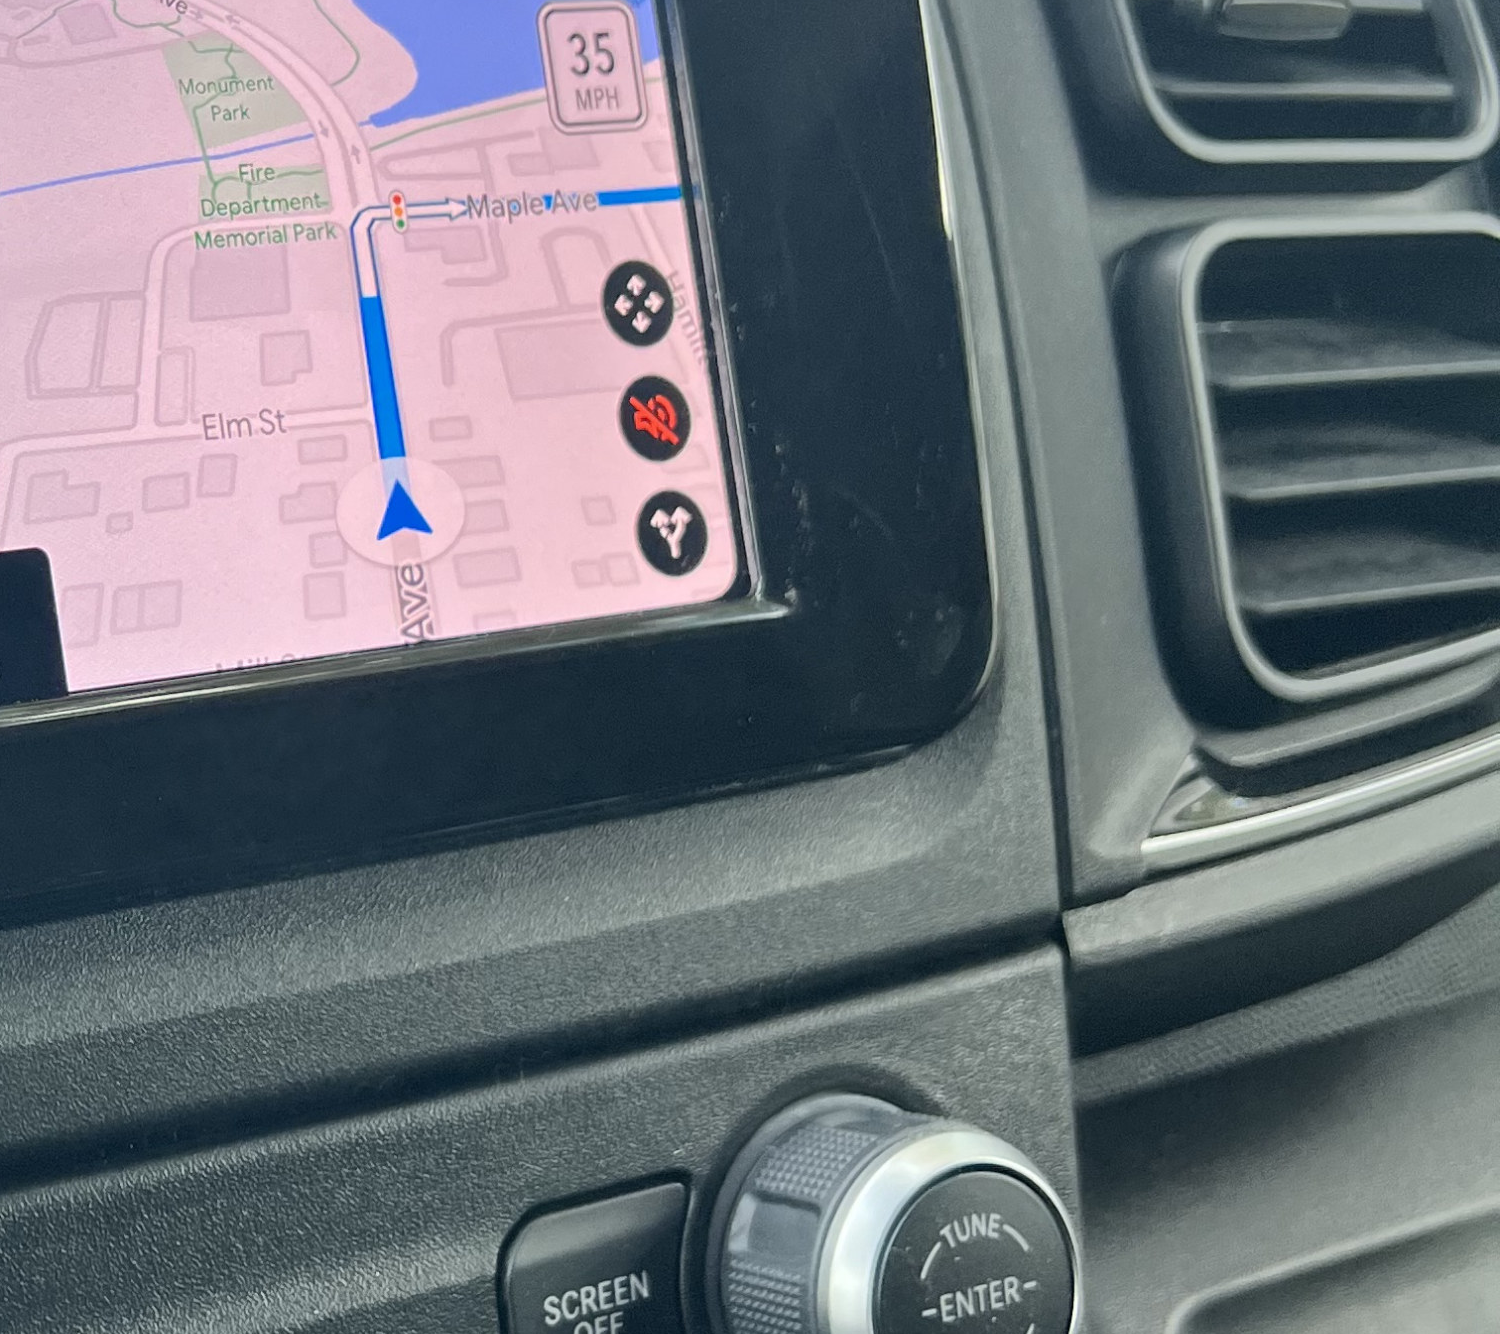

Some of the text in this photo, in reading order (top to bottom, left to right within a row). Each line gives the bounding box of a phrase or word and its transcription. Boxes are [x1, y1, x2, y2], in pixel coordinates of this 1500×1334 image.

[566, 32, 616, 77] 35
[178, 76, 275, 95] Monument
[575, 85, 620, 112] MPH
[211, 104, 251, 122] Park
[238, 163, 275, 182] Fire
[201, 192, 321, 220] Department
[466, 189, 599, 224] Maple Ave
[194, 221, 338, 250] Memorial Park
[202, 408, 288, 441] Elm St
[401, 562, 428, 643] Ave
[939, 1211, 1001, 1244] TUNE
[543, 1270, 650, 1327] SCREEN
[939, 1275, 1021, 1324] ENTER
